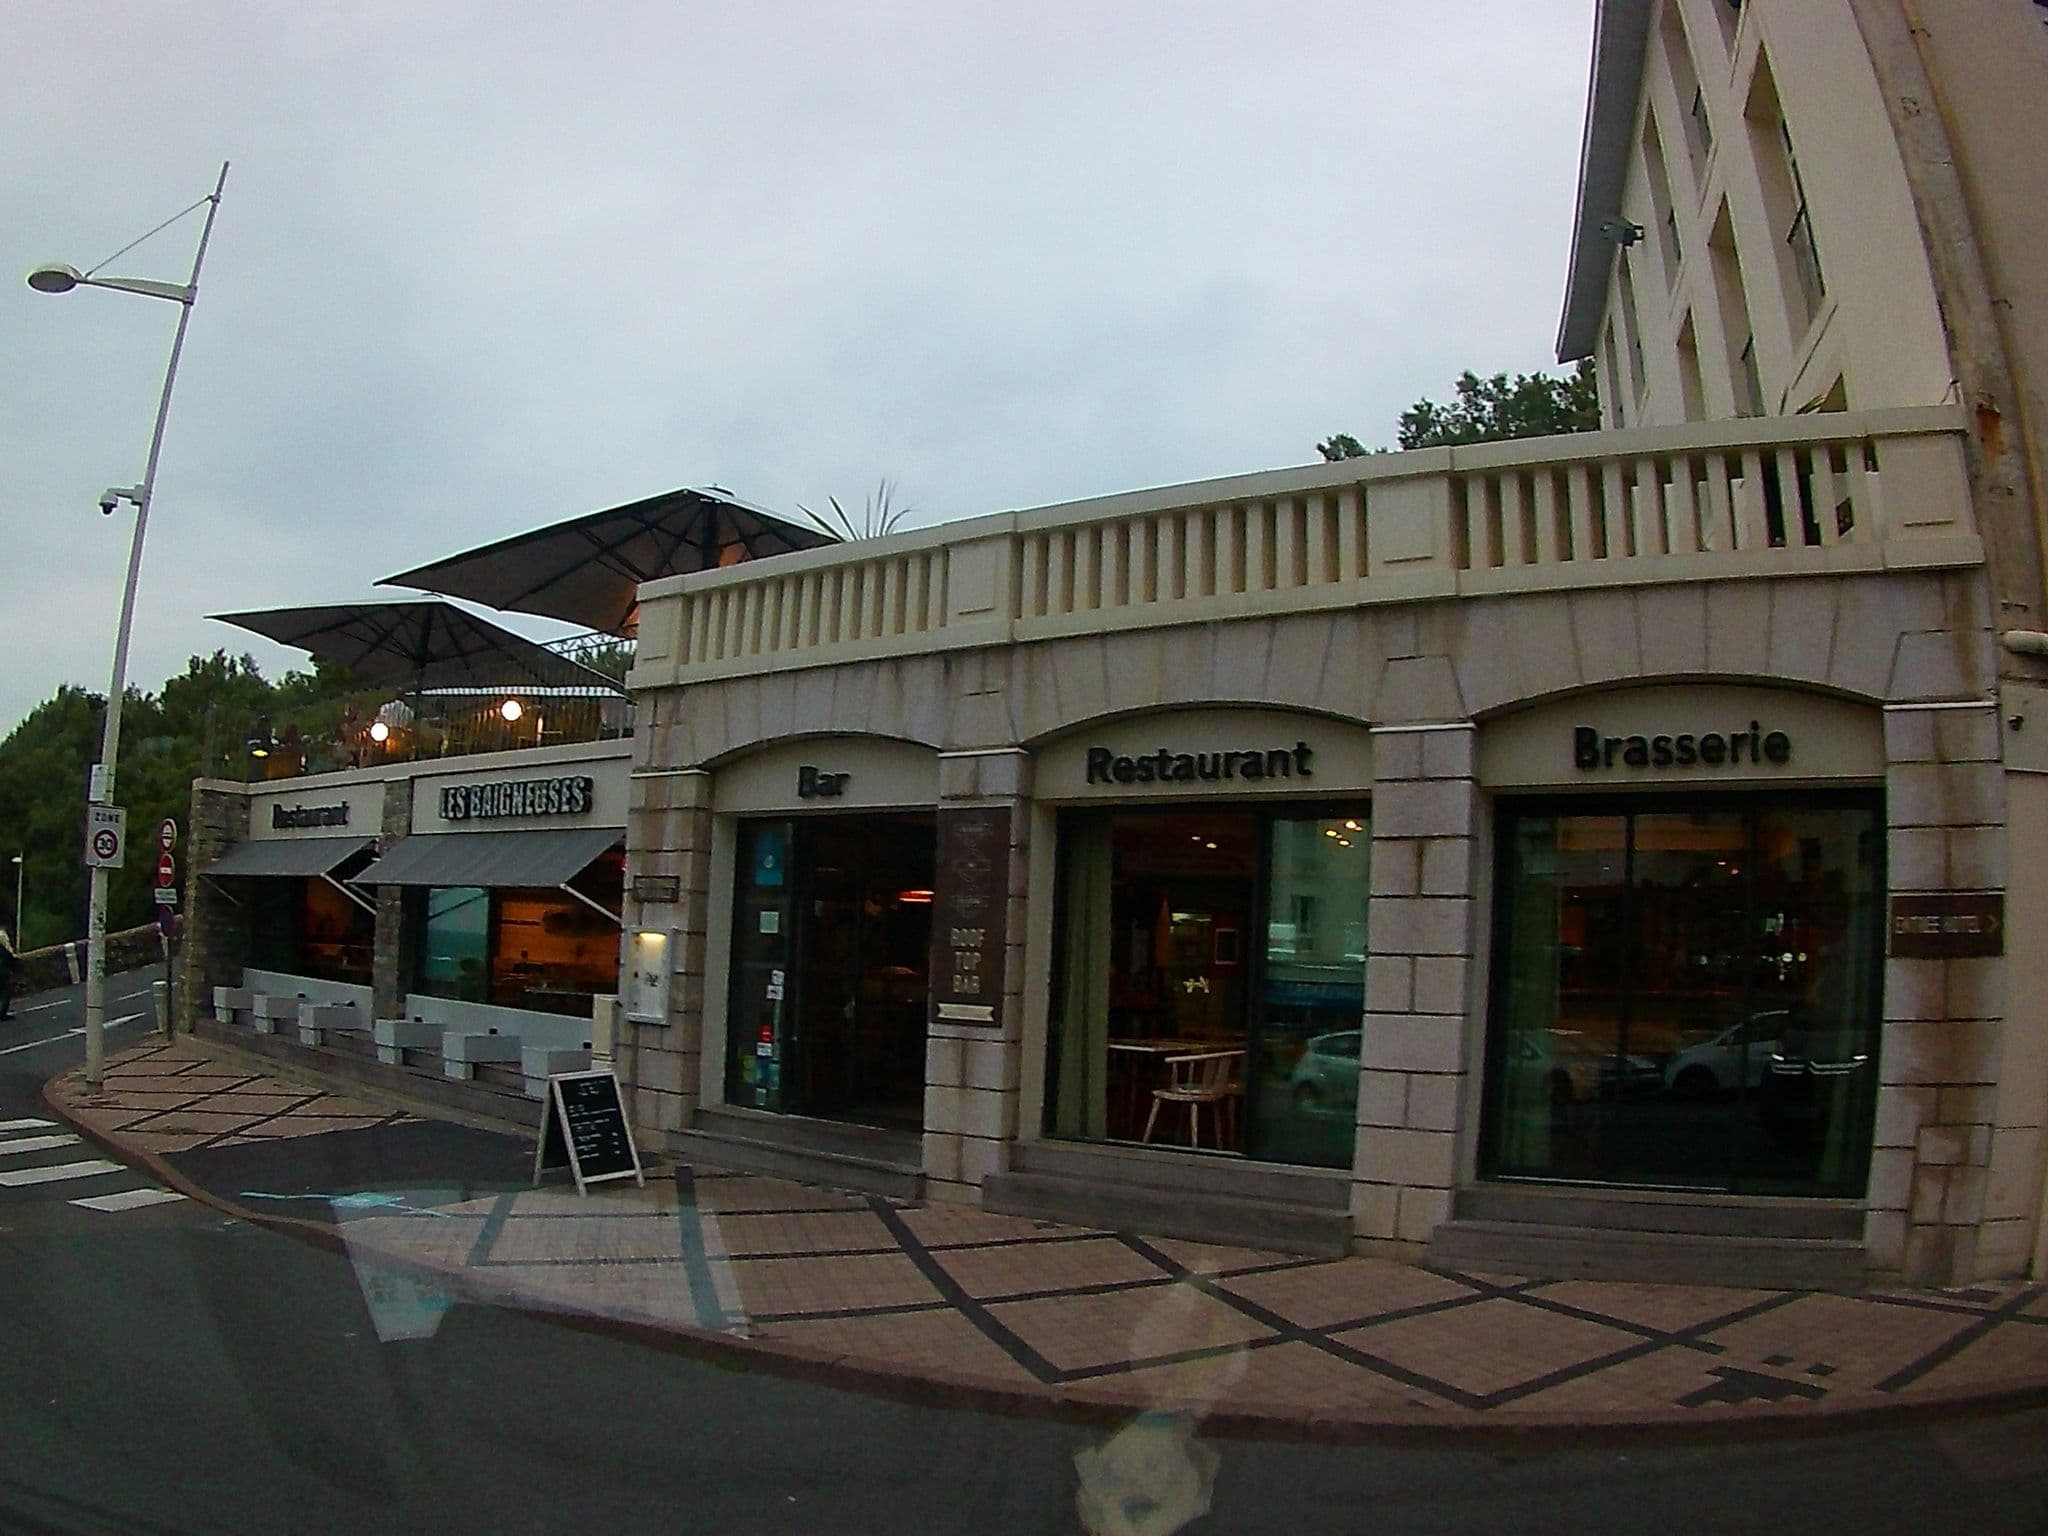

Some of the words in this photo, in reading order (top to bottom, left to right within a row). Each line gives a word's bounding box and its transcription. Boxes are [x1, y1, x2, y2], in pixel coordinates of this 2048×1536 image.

[1574, 720, 1790, 769] Brasserie
[1087, 742, 1313, 784] Restaurant
[799, 766, 850, 798] Bar
[95, 811, 120, 823] ZONE
[440, 786, 467, 820] LES
[97, 838, 113, 851] 30
